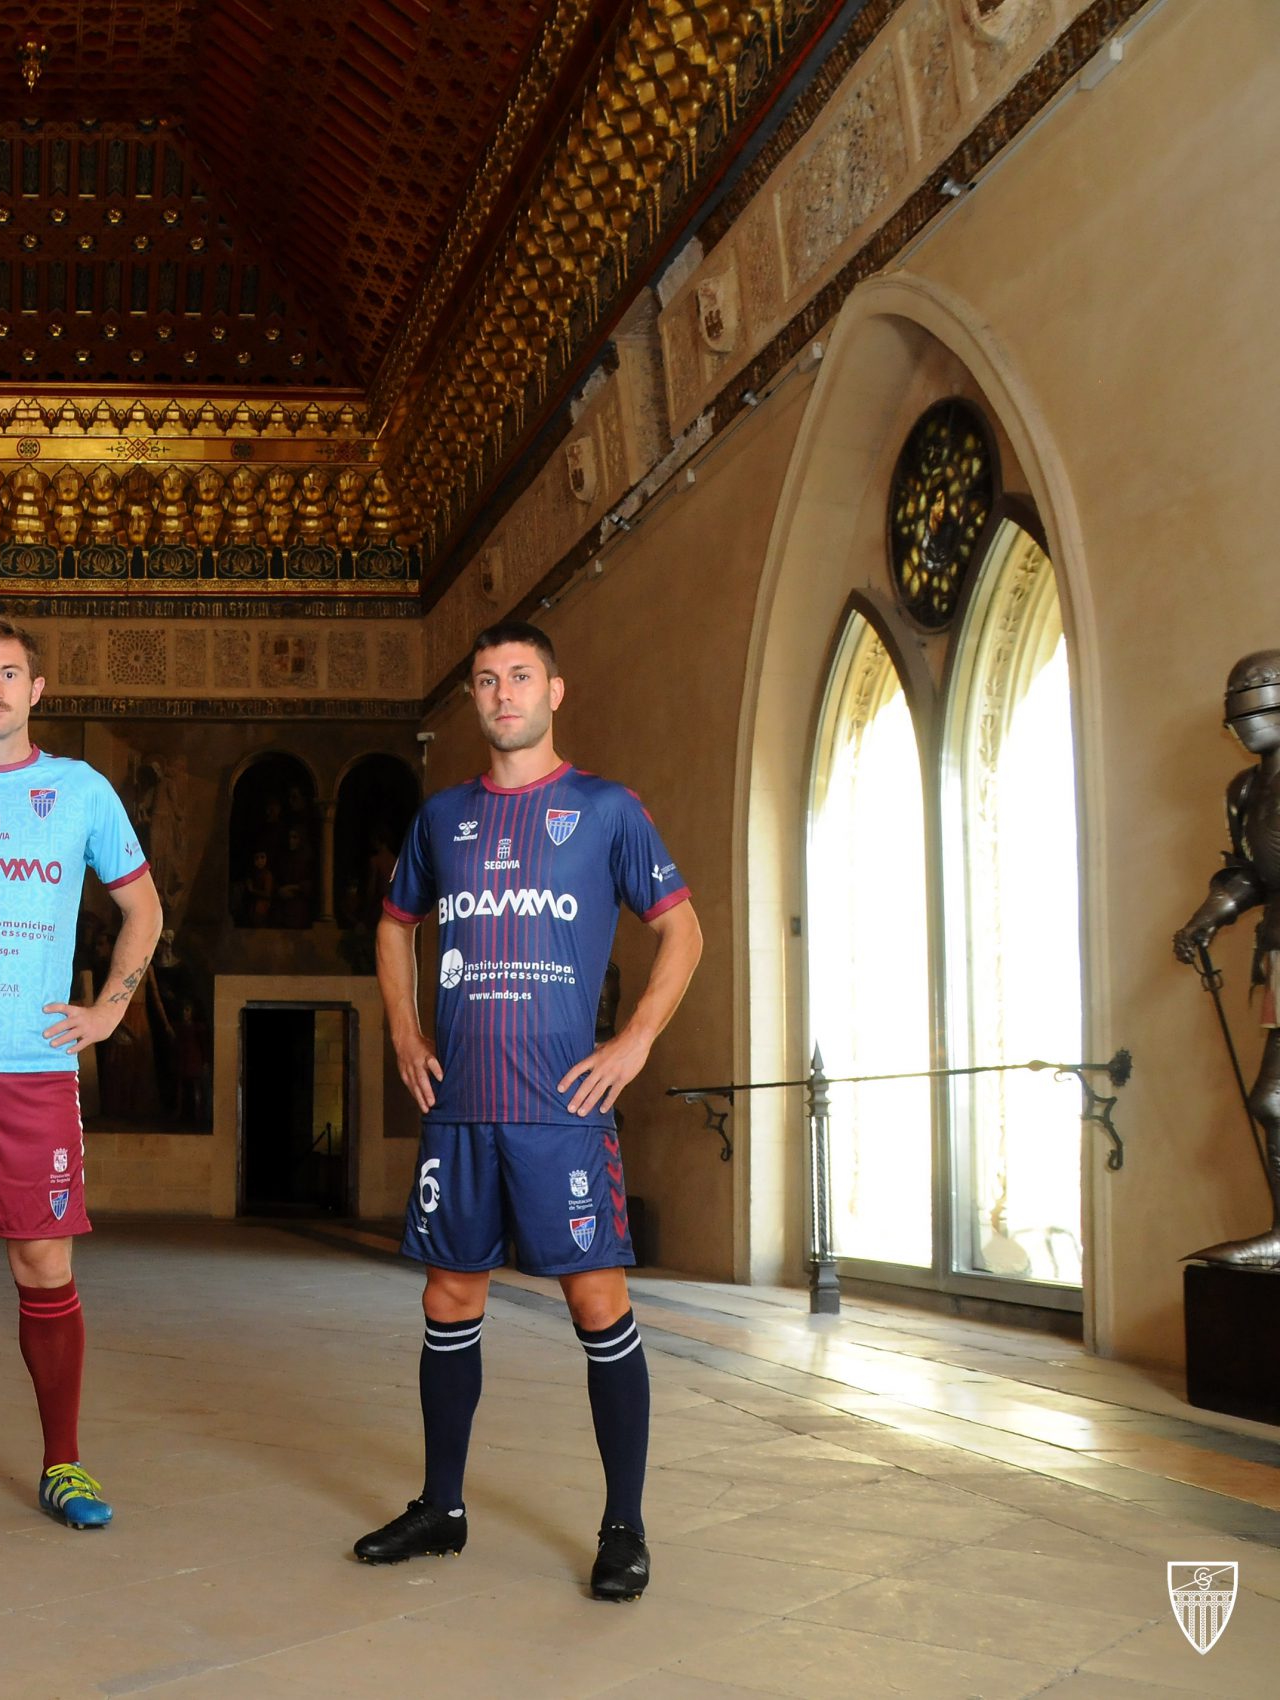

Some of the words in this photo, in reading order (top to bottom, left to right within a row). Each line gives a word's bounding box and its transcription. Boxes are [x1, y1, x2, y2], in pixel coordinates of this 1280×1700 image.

[453, 832, 478, 842] hummel
[484, 859, 520, 870] SEGOVIA
[438, 888, 578, 925] BIOAMMO
[469, 989, 532, 1002] www.imdsg.es
[419, 1158, 441, 1213] 6
